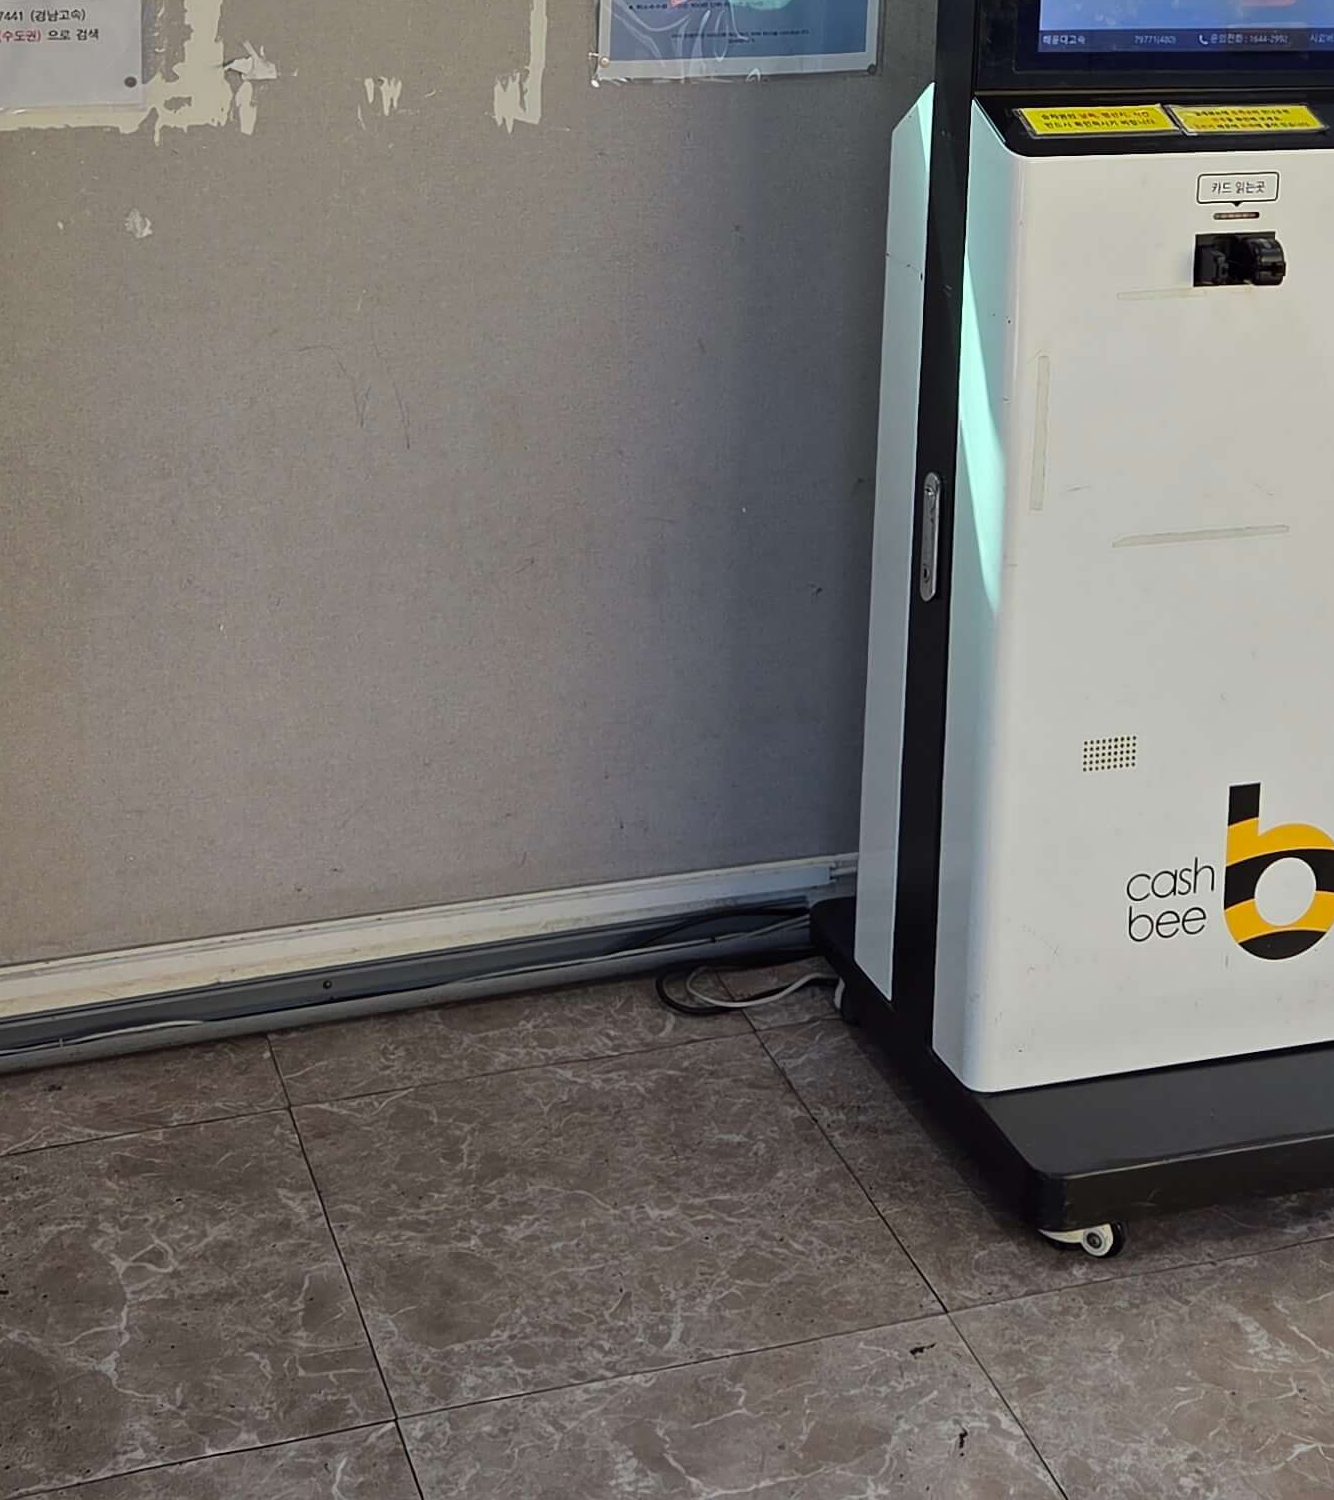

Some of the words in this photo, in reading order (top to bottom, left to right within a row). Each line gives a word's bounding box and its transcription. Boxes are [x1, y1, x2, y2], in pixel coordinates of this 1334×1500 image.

[48, 29, 71, 41] 으로
[76, 27, 99, 41] 검색
[1211, 181, 1232, 194] 카드
[1235, 180, 1266, 194] 읽는곳
[1125, 856, 1216, 903] cash
[1126, 905, 1208, 943] bee
